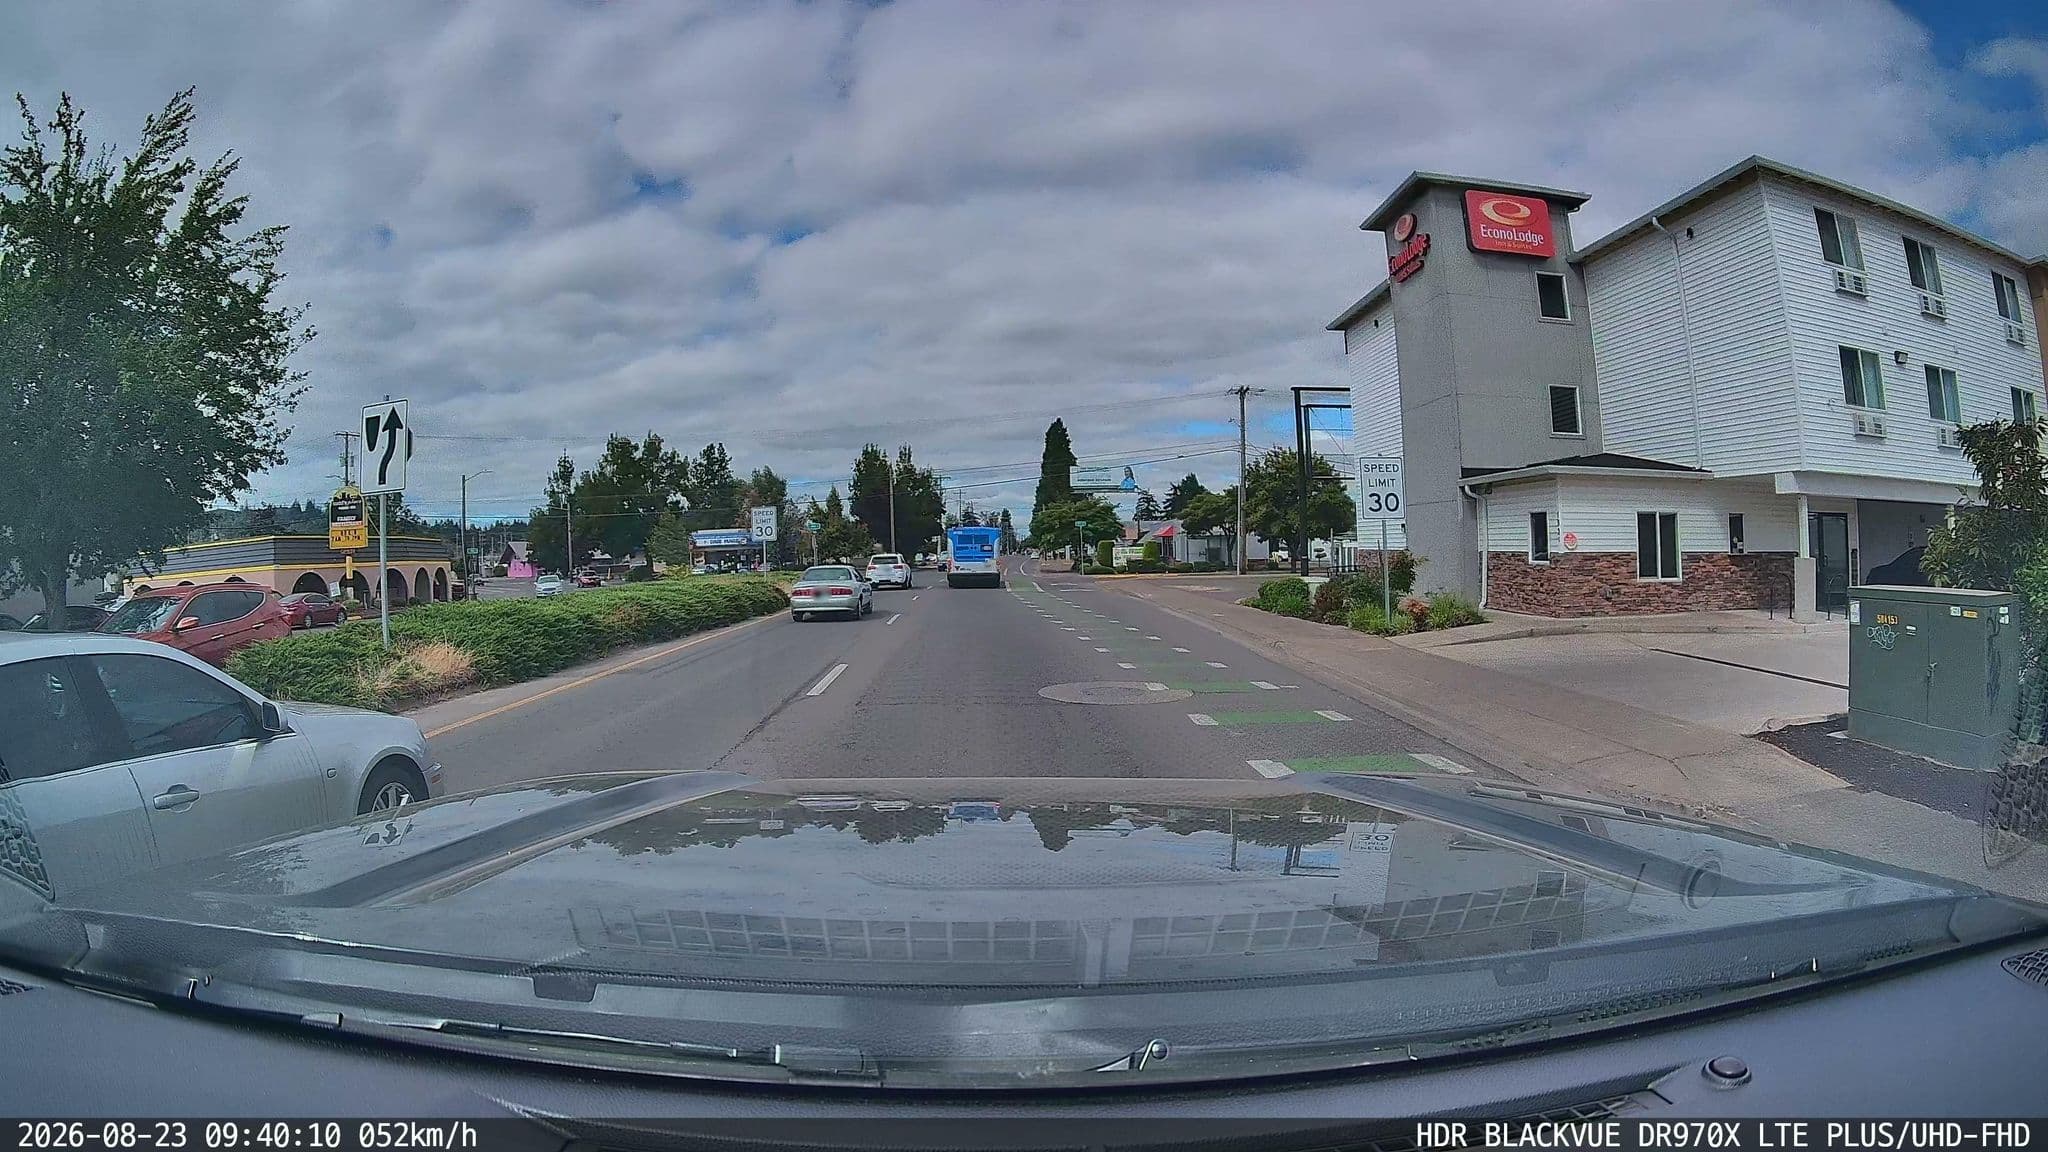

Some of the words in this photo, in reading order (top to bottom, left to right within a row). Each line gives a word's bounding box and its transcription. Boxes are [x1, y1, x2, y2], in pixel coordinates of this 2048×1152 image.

[1480, 224, 1544, 246] EconoLodge
[1363, 464, 1400, 473] SPEED
[1368, 478, 1396, 488] LIMIT
[1368, 492, 1400, 512] 30
[755, 526, 773, 537] 30
